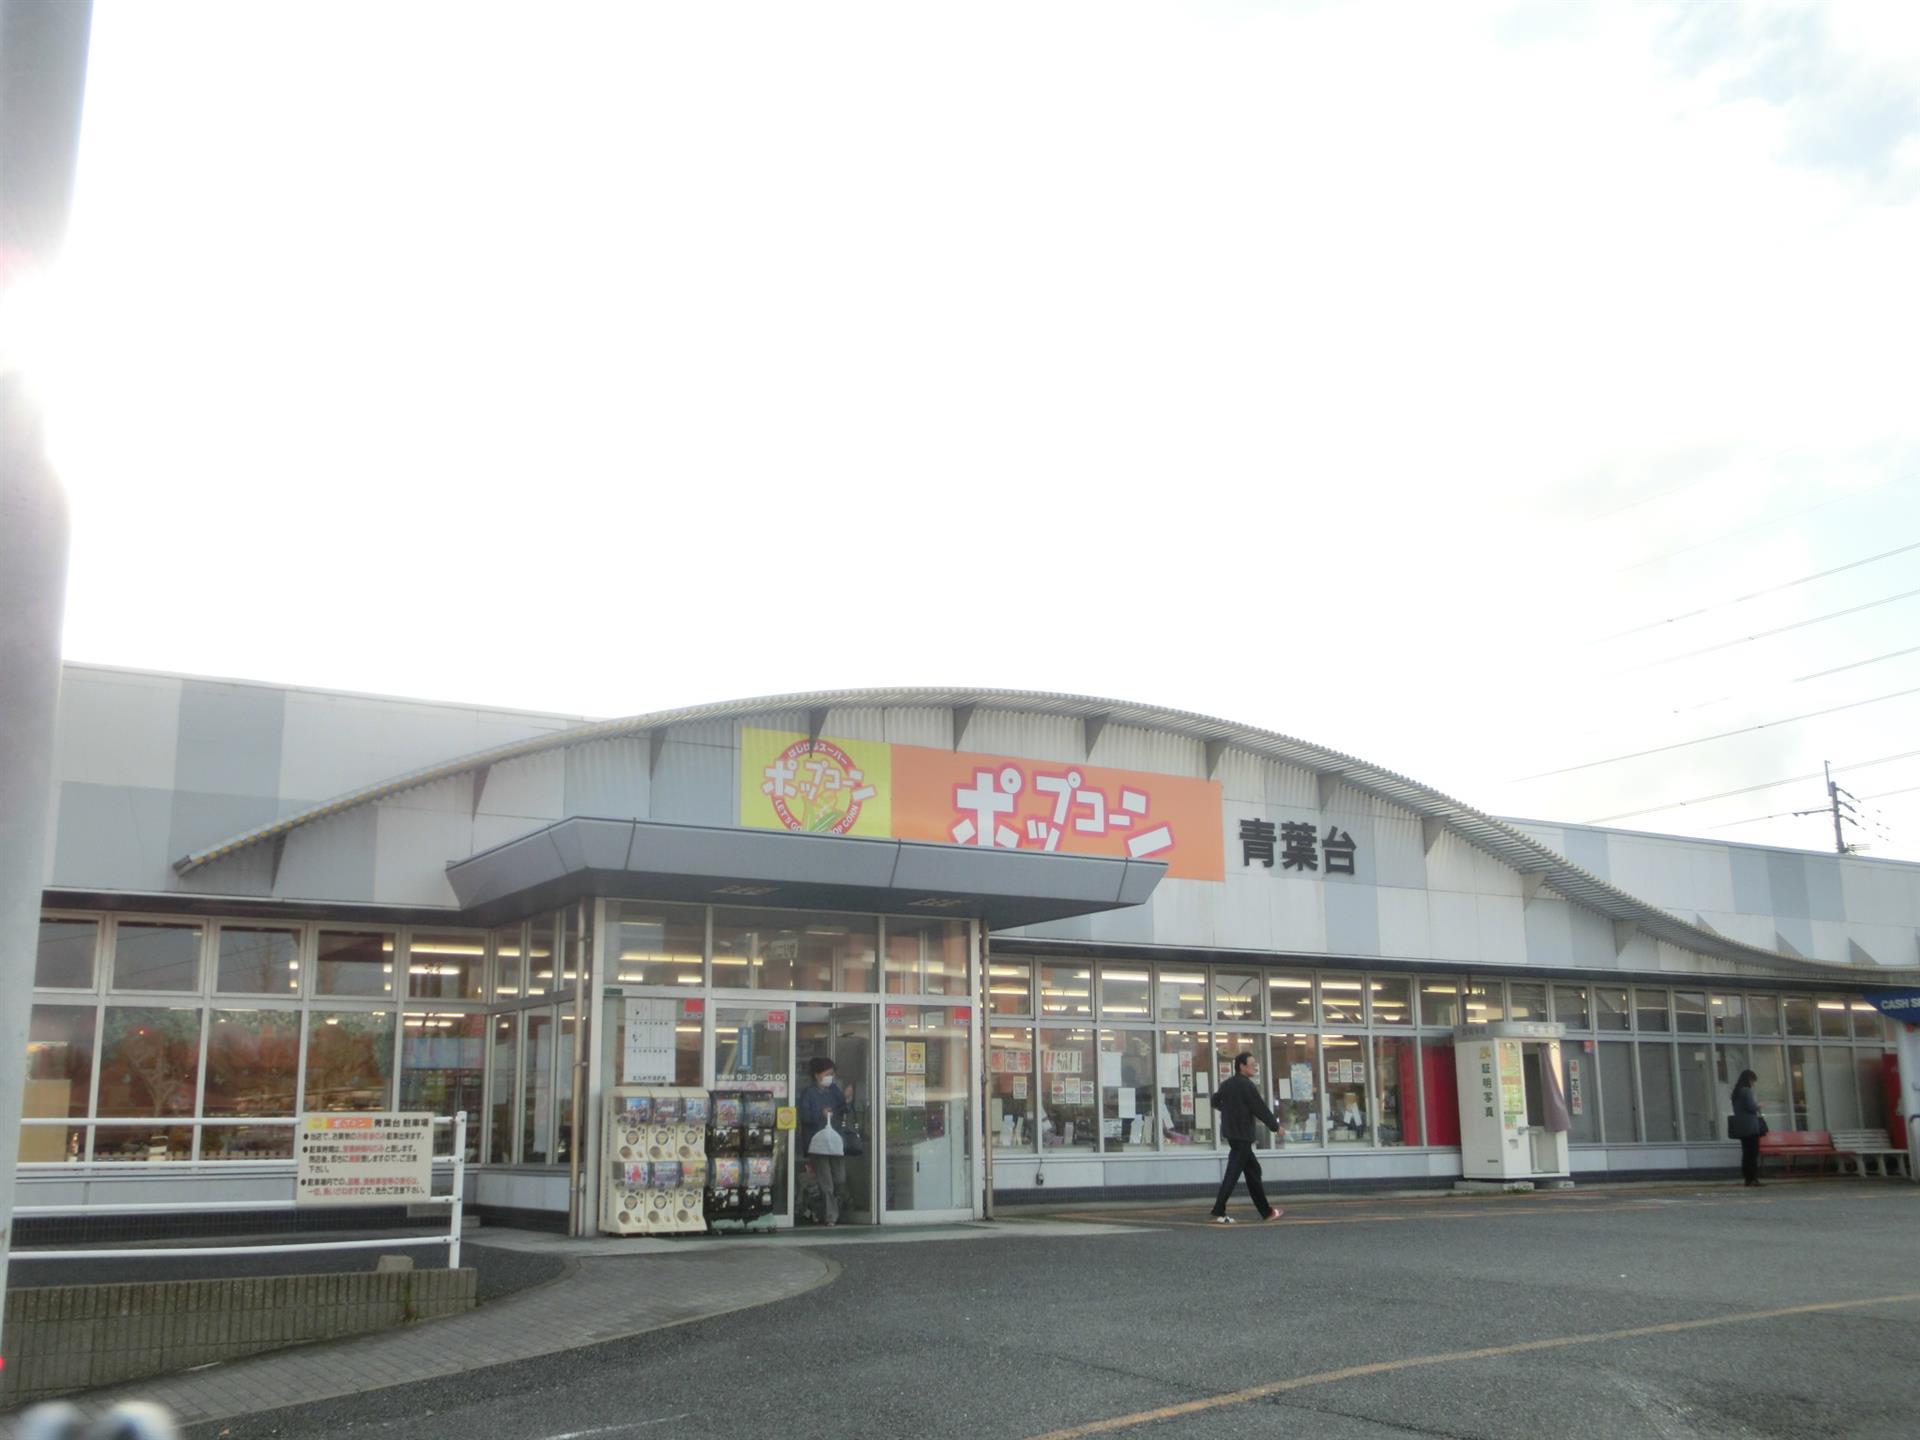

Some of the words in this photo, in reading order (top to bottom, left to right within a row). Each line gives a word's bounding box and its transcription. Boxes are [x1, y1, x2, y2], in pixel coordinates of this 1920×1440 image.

[762, 760, 875, 800] ポップコーン
[951, 767, 1173, 858] ポップコーン
[1240, 818, 1357, 876] 青葉台
[1881, 999, 1910, 1010] CASH
[1481, 1063, 1494, 1117] 証明写真
[374, 1118, 401, 1128] 青葉台
[403, 1118, 429, 1128] 駐車場
